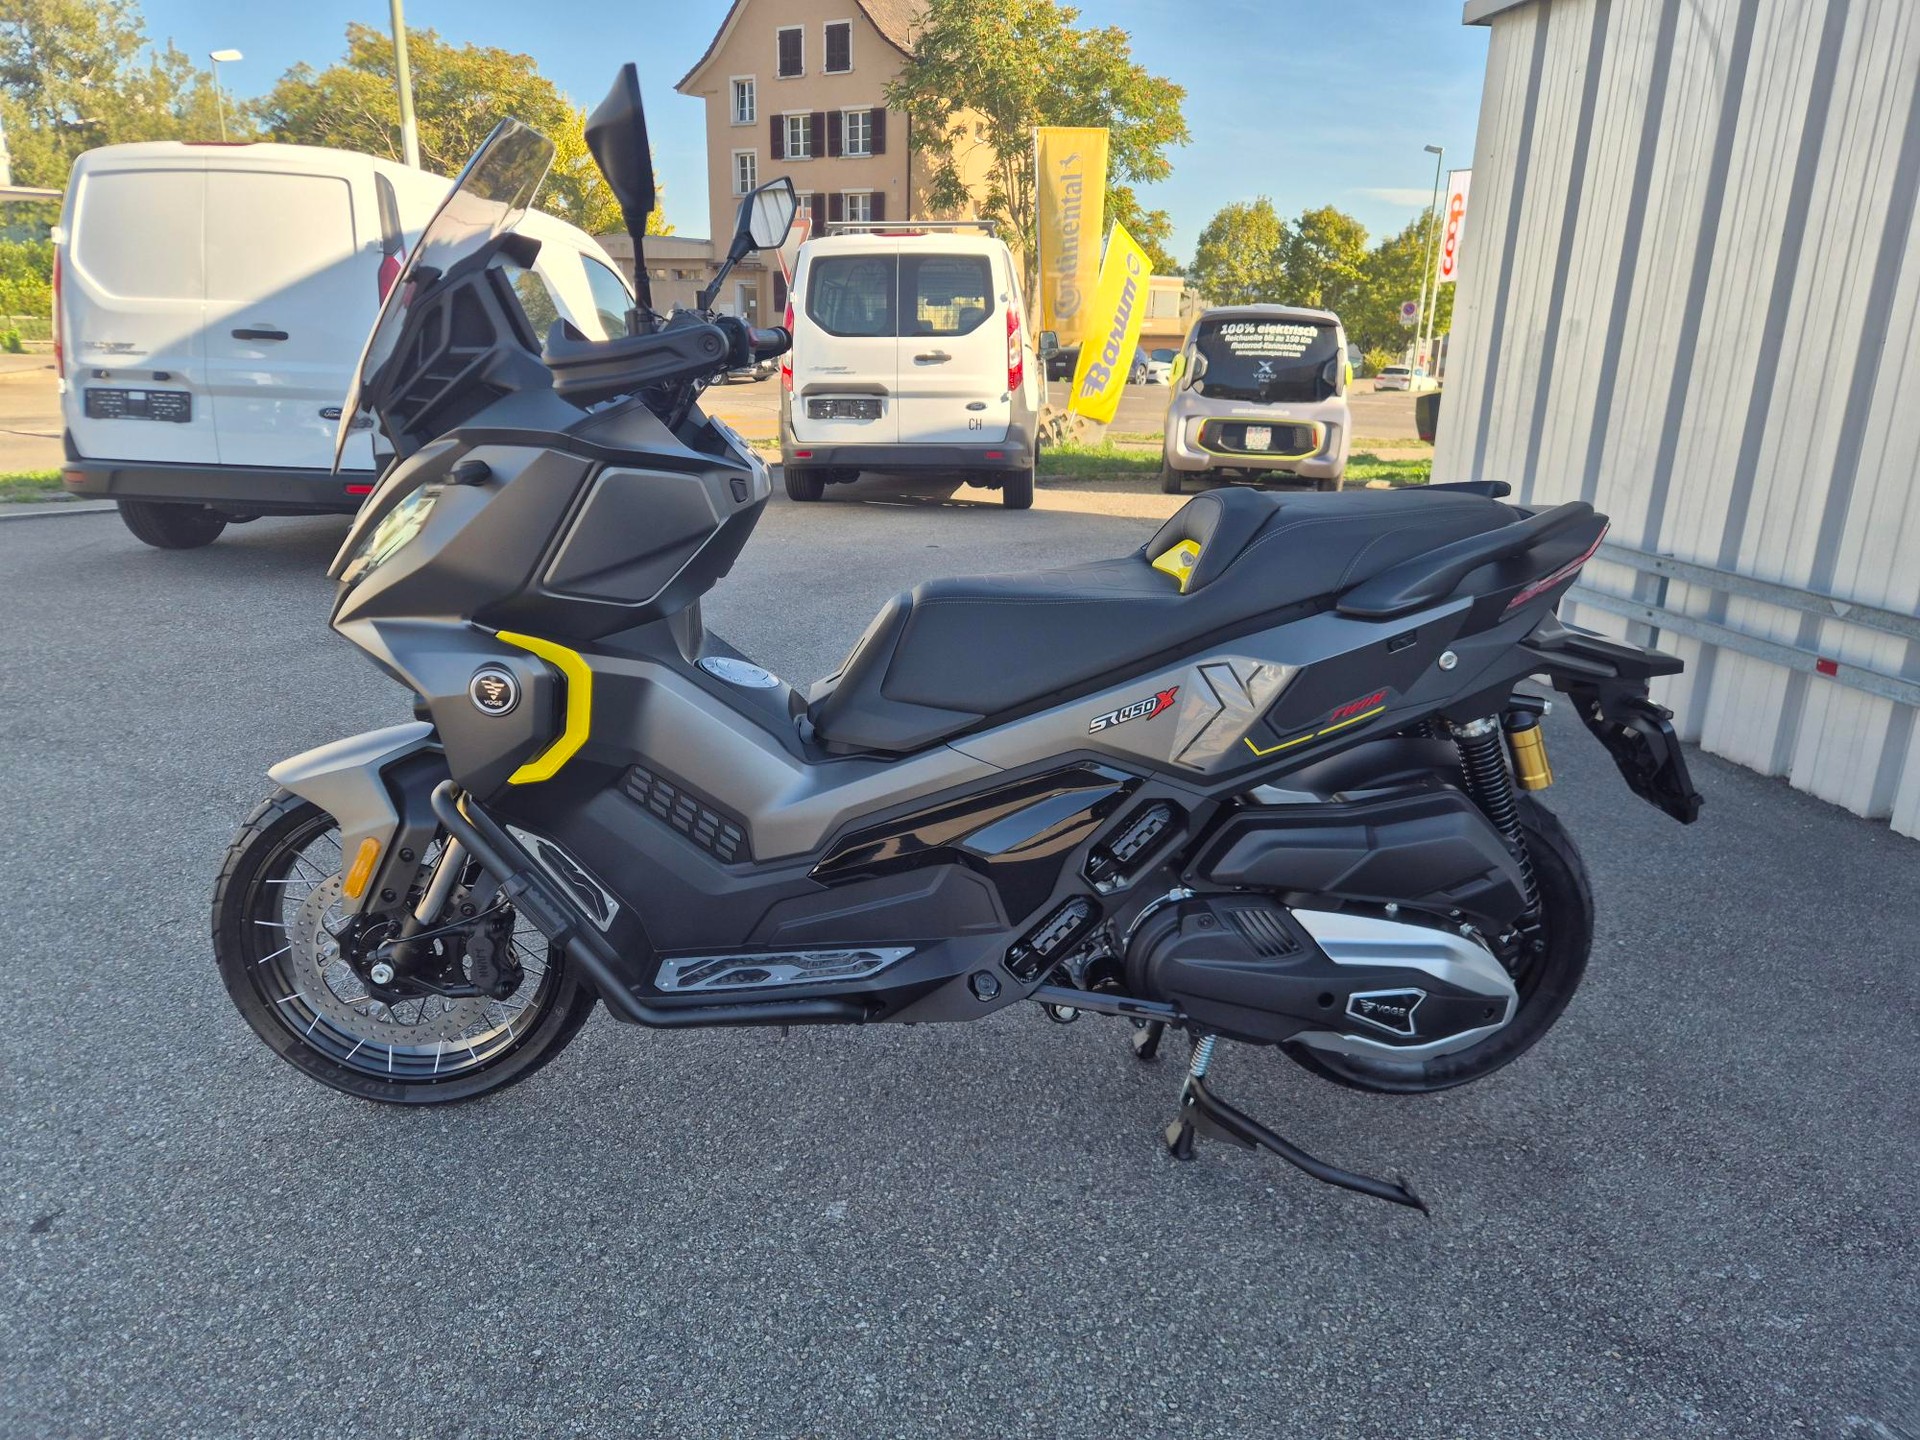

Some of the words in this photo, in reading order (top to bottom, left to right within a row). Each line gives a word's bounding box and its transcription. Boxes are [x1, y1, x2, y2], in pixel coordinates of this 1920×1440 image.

[1443, 193, 1464, 275] coop
[1054, 174, 1082, 321] Continental
[1083, 277, 1137, 396] Barum
[1220, 324, 1255, 335] 100%
[1257, 324, 1318, 338] elektrisch
[968, 417, 982, 431] CH
[483, 699, 503, 707] VOGE
[1376, 1004, 1406, 1016] VOGE
